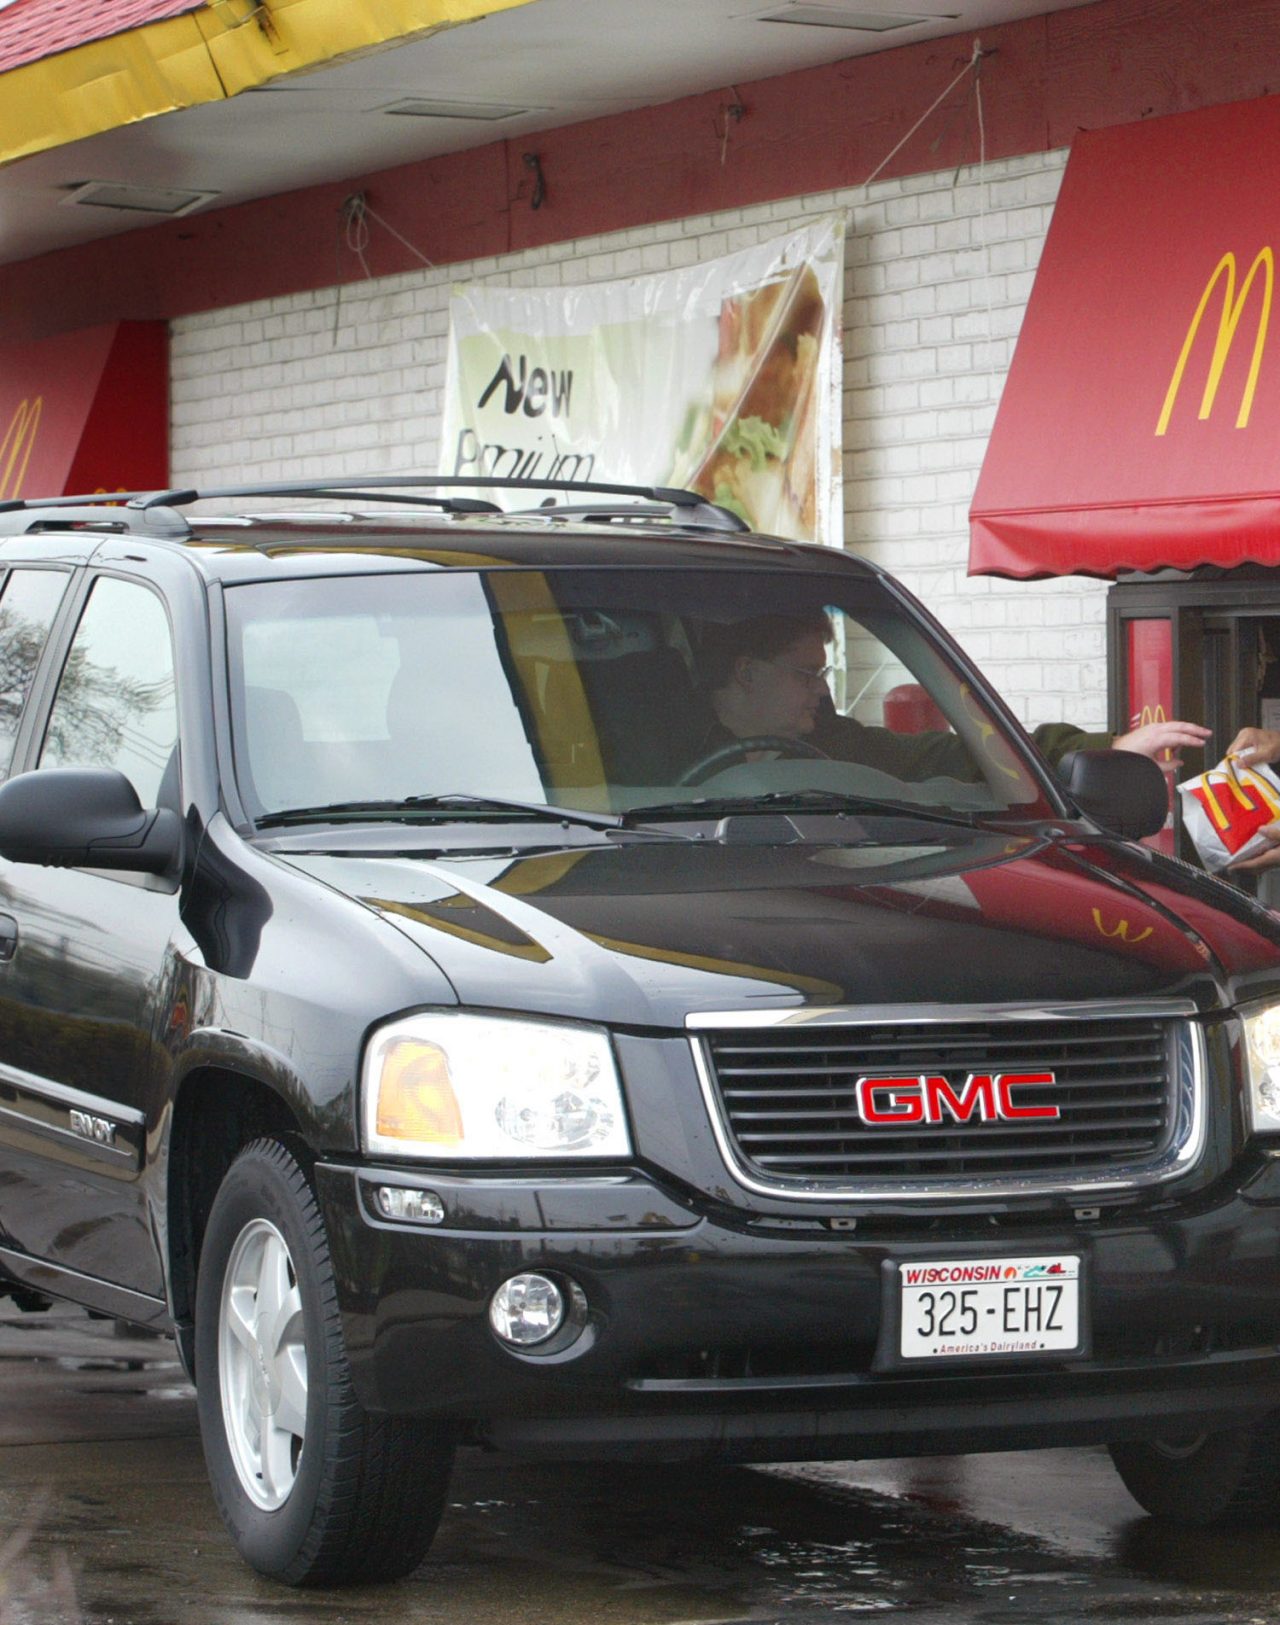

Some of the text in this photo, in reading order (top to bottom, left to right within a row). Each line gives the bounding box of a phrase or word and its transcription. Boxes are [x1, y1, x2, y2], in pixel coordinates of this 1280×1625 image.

[477, 352, 574, 419] New
[855, 1071, 1061, 1126] GMC
[906, 1265, 1001, 1285] WISCONSIN
[917, 1285, 1064, 1337] 325-EHZ
[940, 1340, 1037, 1354] America's Dairyland
